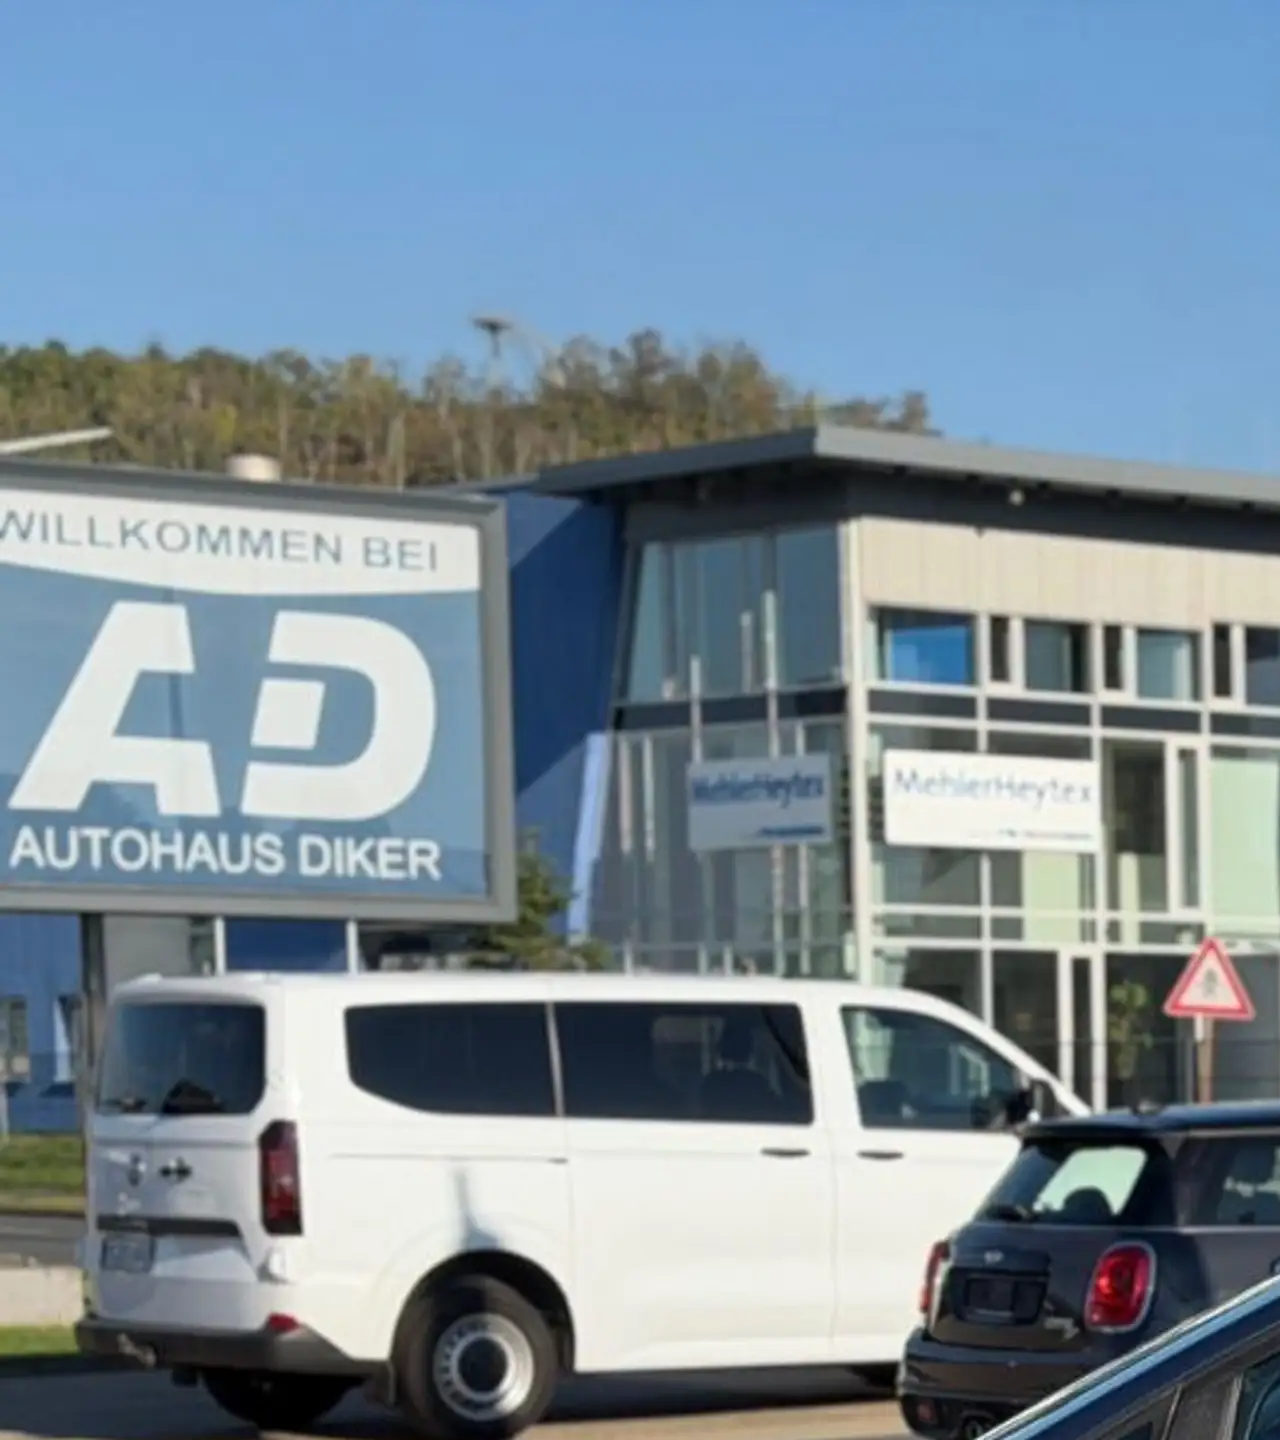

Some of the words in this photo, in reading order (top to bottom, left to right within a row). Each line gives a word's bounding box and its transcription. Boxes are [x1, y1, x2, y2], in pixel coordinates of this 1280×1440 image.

[0, 509, 342, 565] WILLKOMMEN
[362, 536, 438, 572] BEI
[9, 599, 436, 821] AD
[9, 824, 287, 877] AUTOHAUS
[299, 835, 442, 881] DIKER
